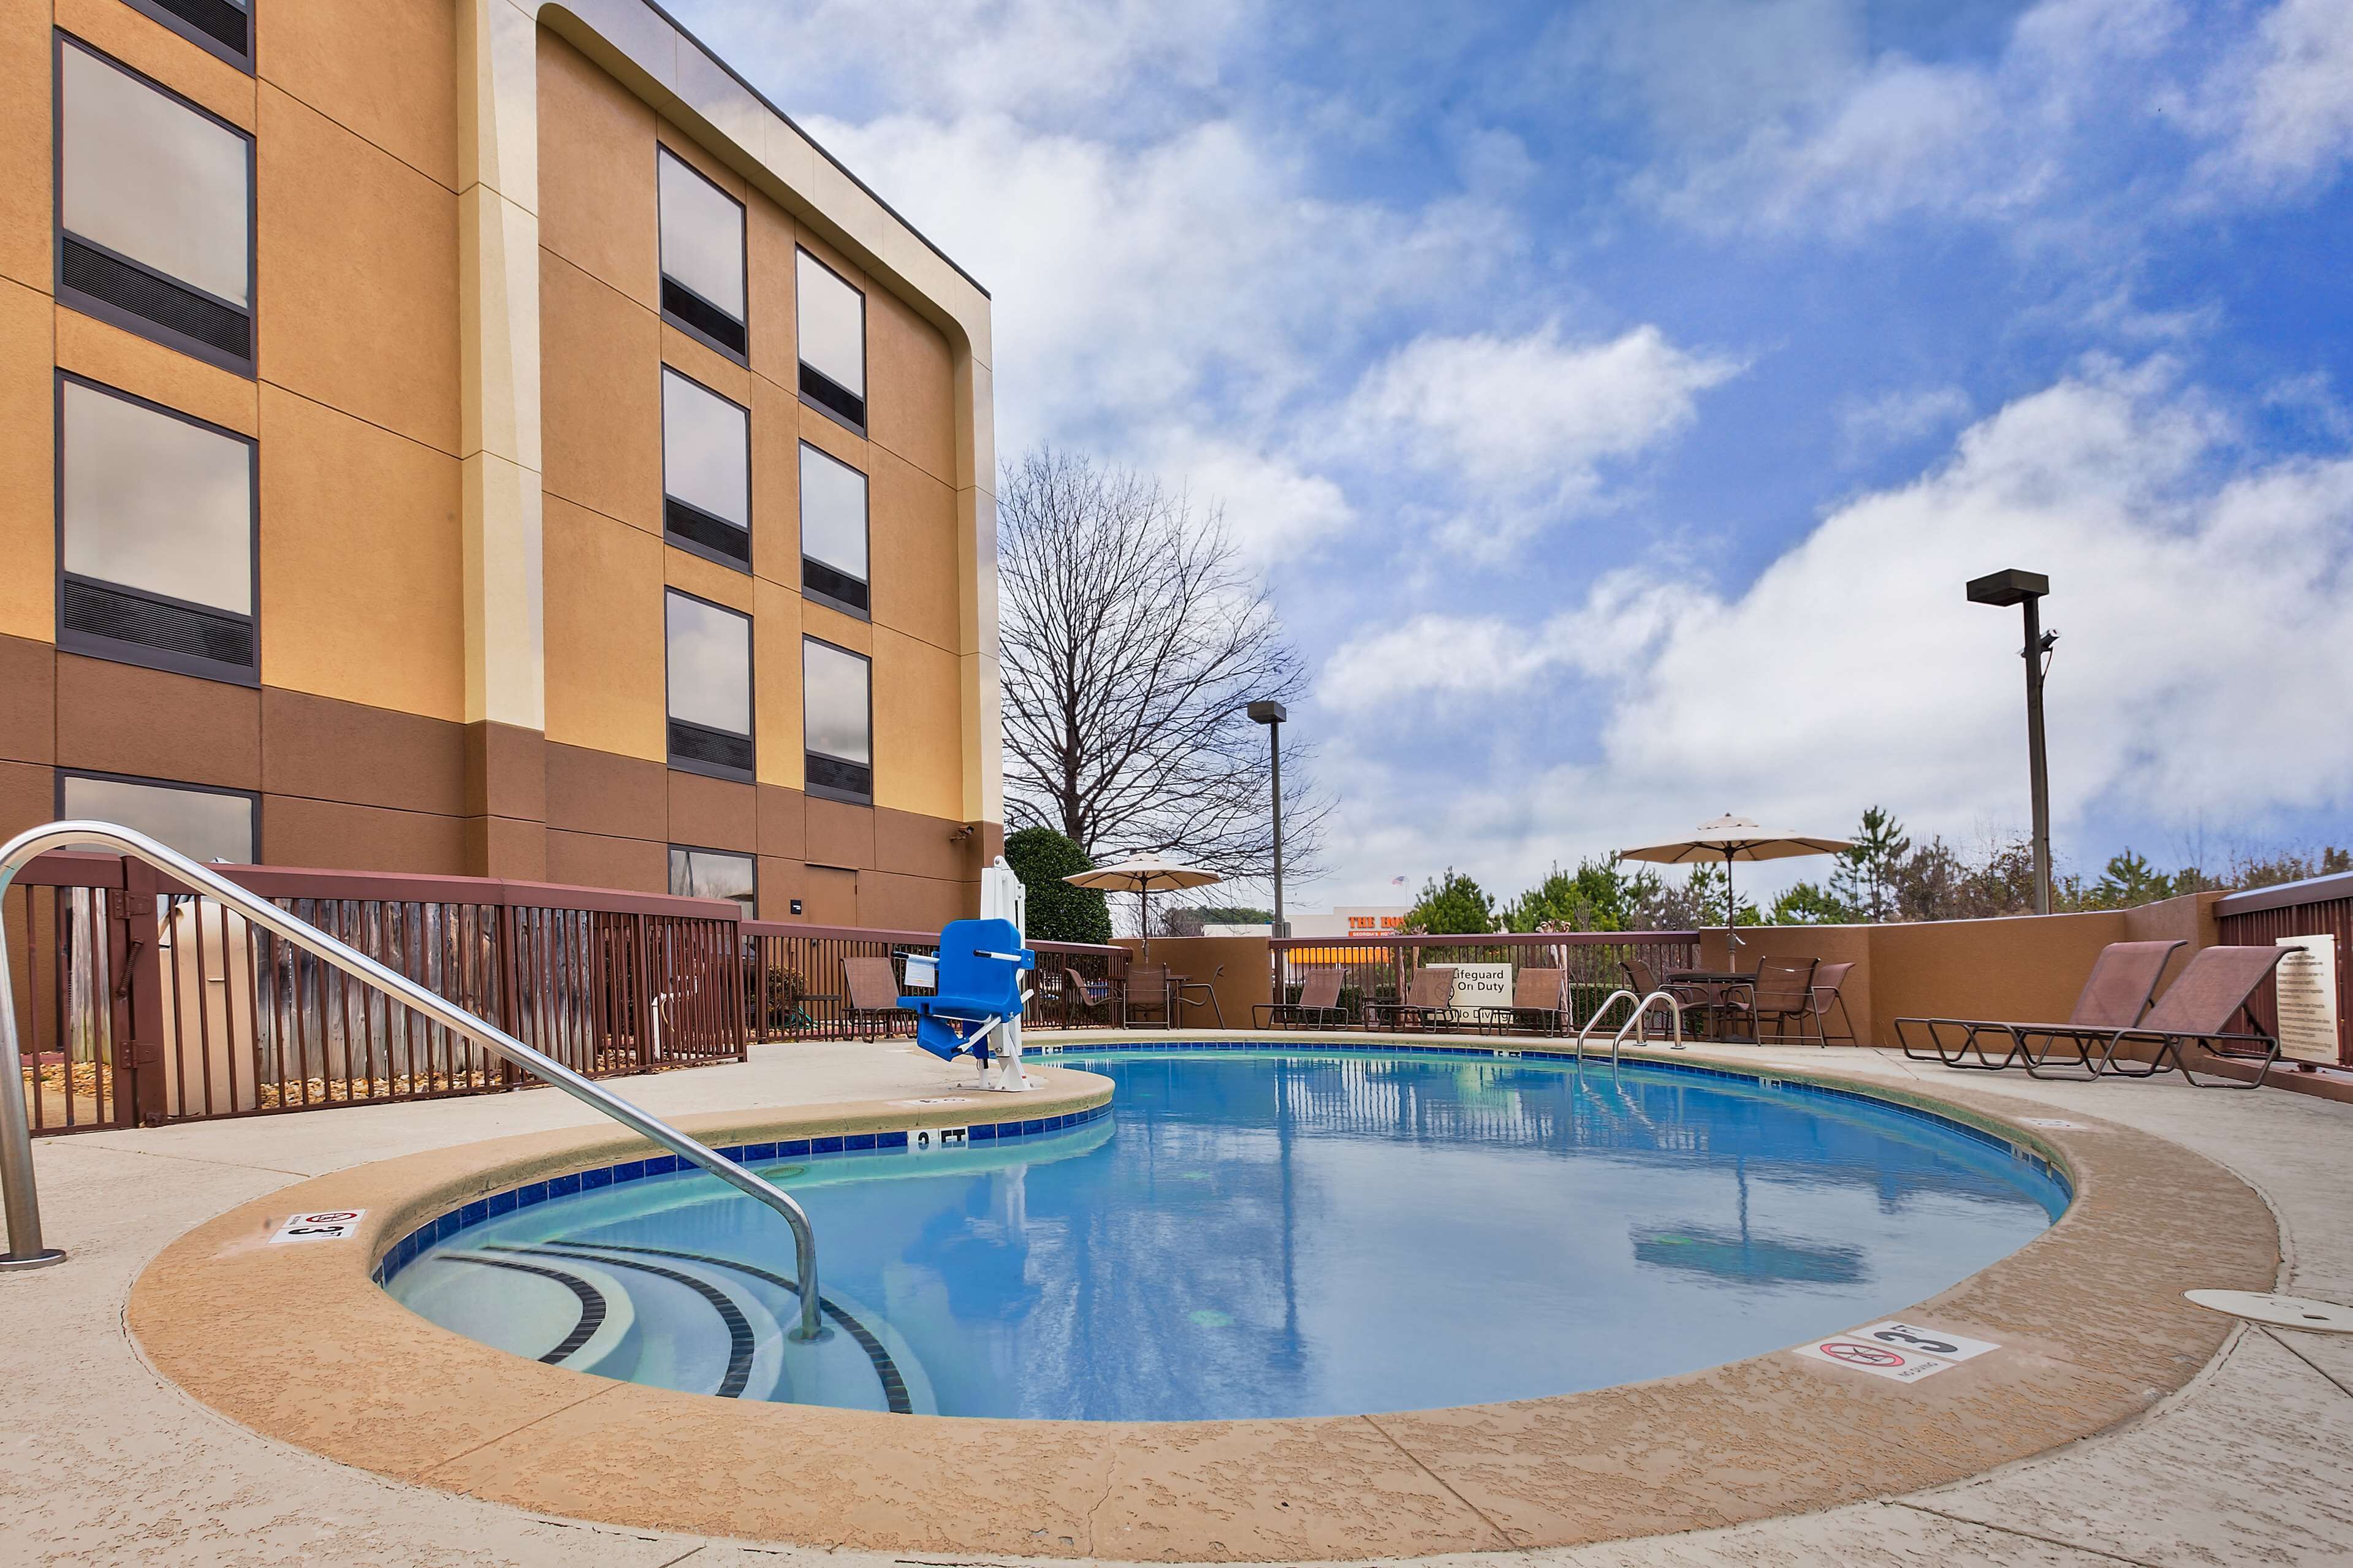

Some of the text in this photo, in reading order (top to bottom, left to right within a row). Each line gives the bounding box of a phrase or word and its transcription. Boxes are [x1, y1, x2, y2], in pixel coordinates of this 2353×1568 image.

[1348, 917, 1375, 928] THE
[1458, 982, 1504, 993] On Duty
[1454, 1010, 1469, 1018] No
[1874, 1331, 1958, 1352] 3
[1910, 1361, 1938, 1373] DIVING
